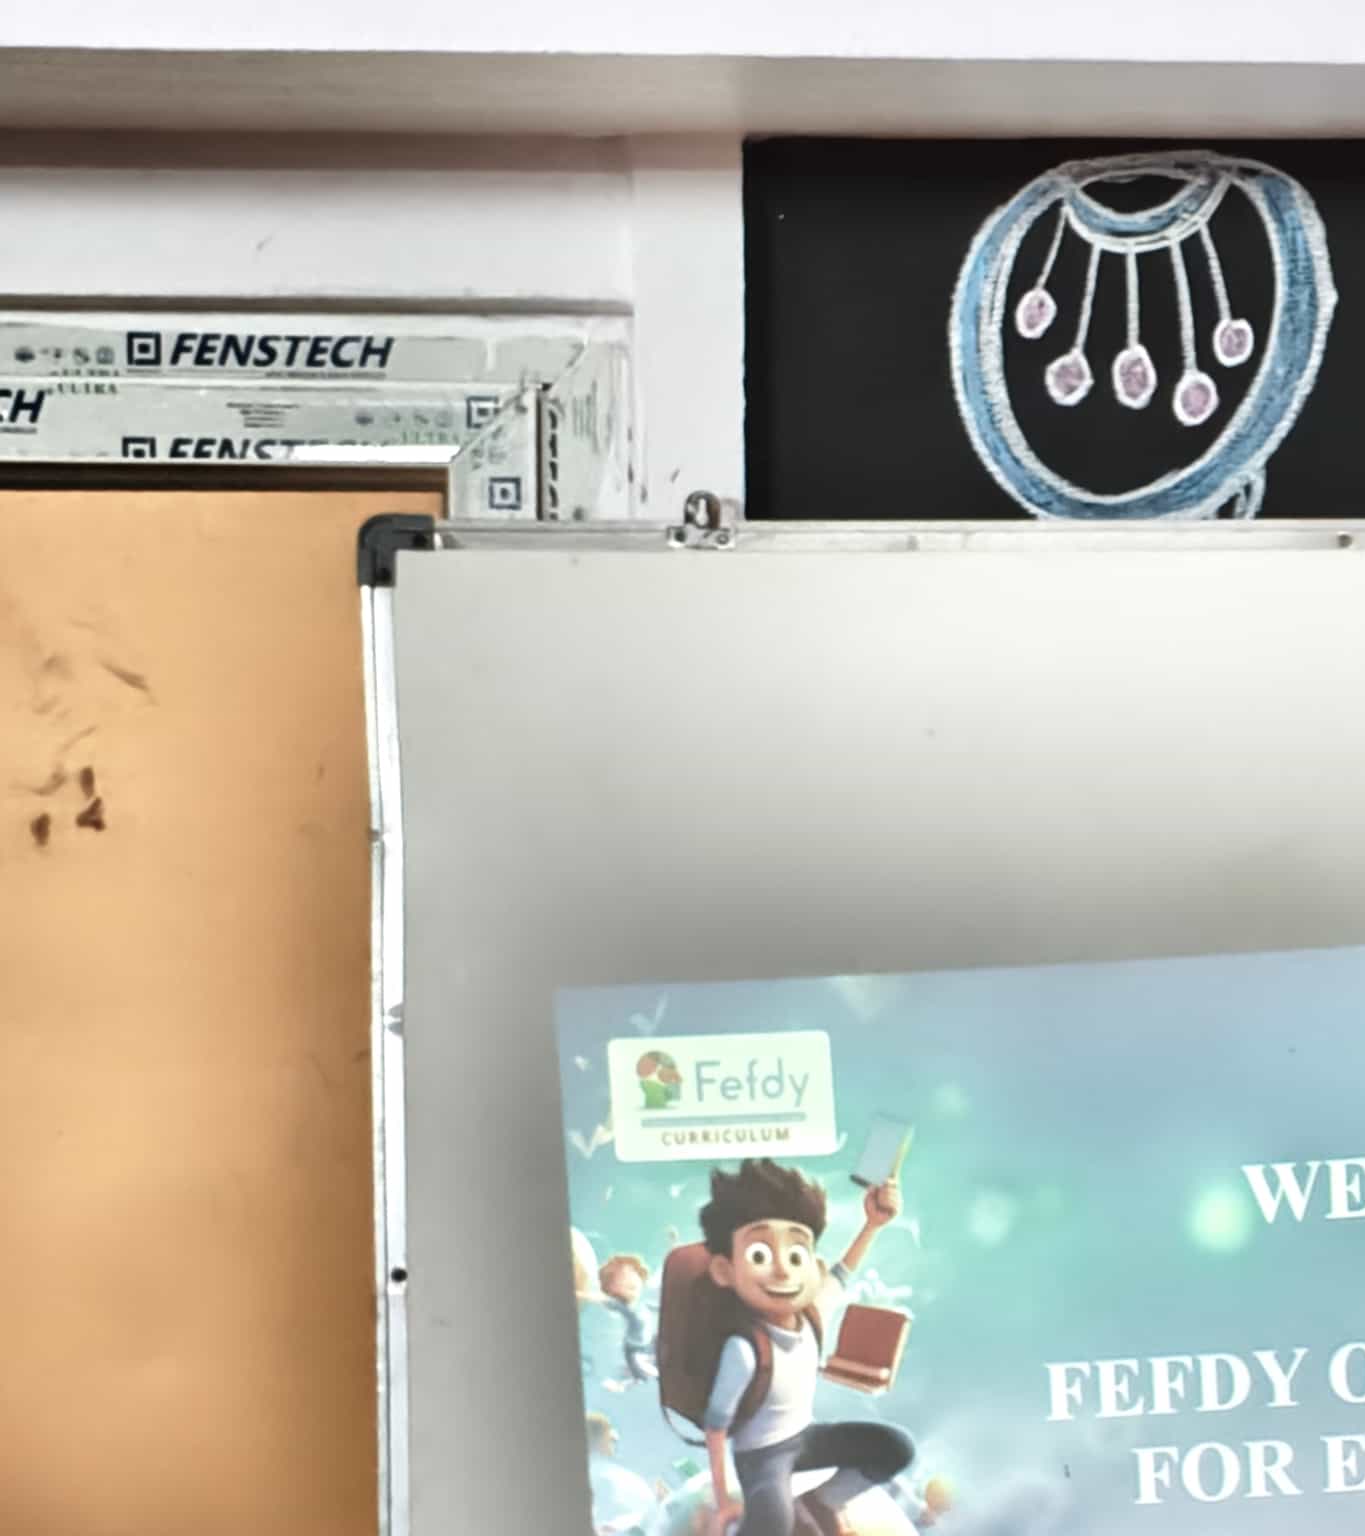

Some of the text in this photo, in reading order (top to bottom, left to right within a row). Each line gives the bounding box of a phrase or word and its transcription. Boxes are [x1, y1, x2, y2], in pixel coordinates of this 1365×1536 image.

[169, 332, 394, 369] FENSTECH
[694, 1057, 809, 1107] Fefdy
[661, 1127, 790, 1146] CURRICULUM
[1044, 1348, 1308, 1423] FEFDY
[1133, 1439, 1304, 1505] FOR
